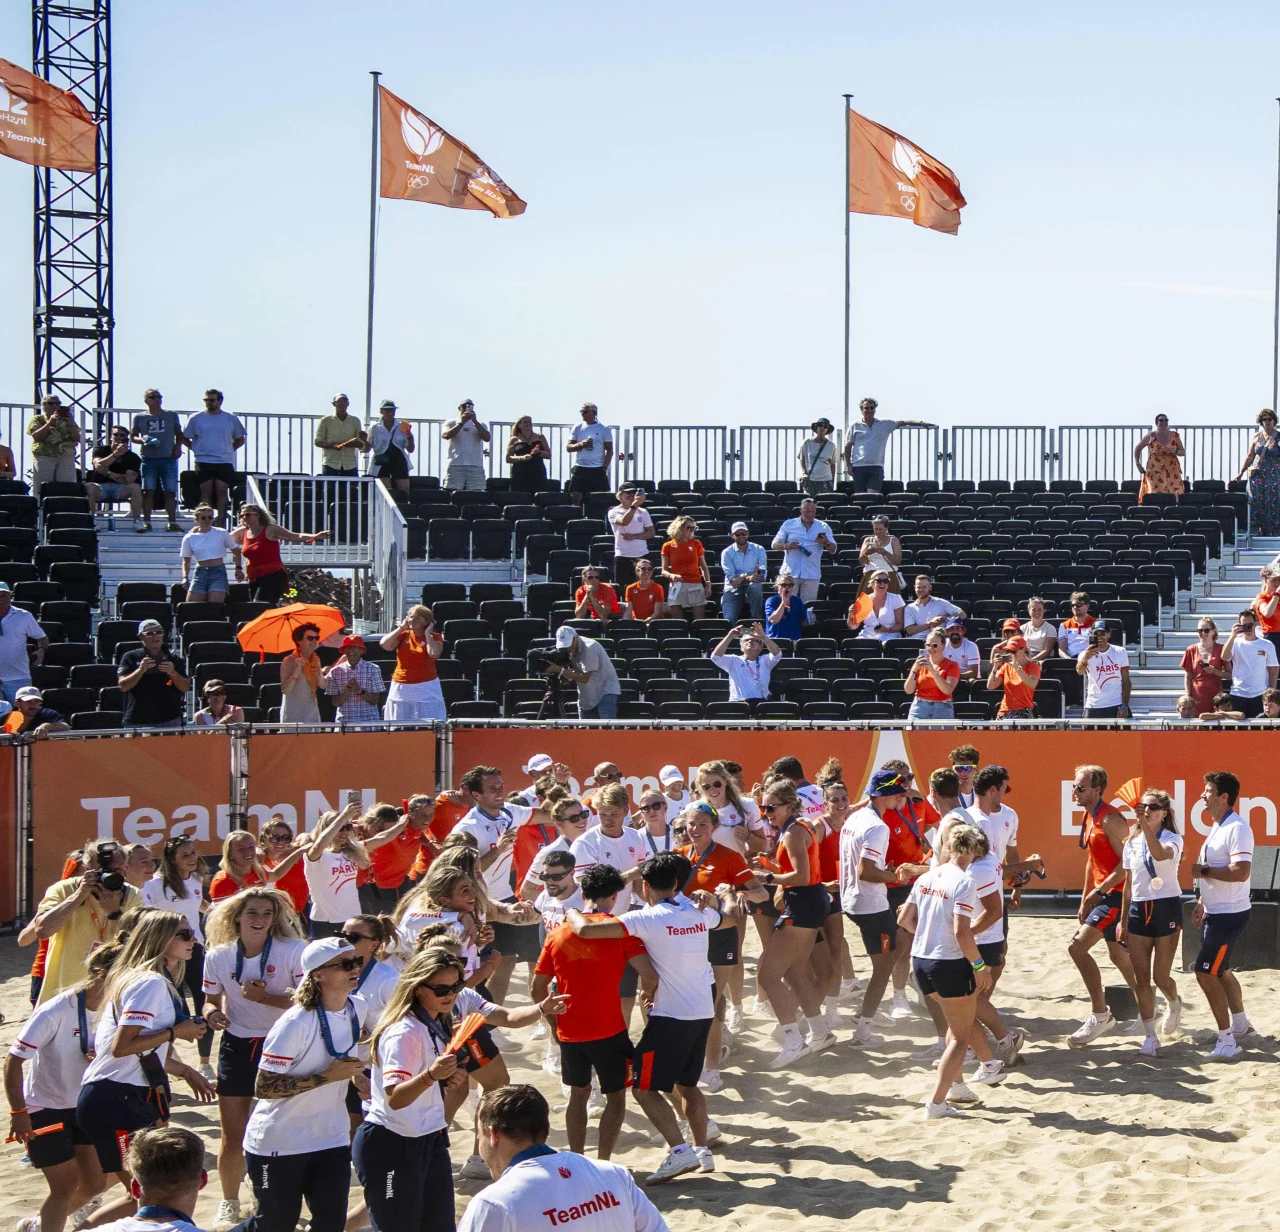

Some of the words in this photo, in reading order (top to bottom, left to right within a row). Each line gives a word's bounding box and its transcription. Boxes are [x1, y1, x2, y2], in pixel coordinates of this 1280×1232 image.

[7, 130, 48, 146] TeamNL
[405, 160, 435, 174] TeamNL
[920, 885, 948, 899] TeamNL
[386, 1170, 395, 1199] TeamNL
[542, 1190, 620, 1226] TeamNL
